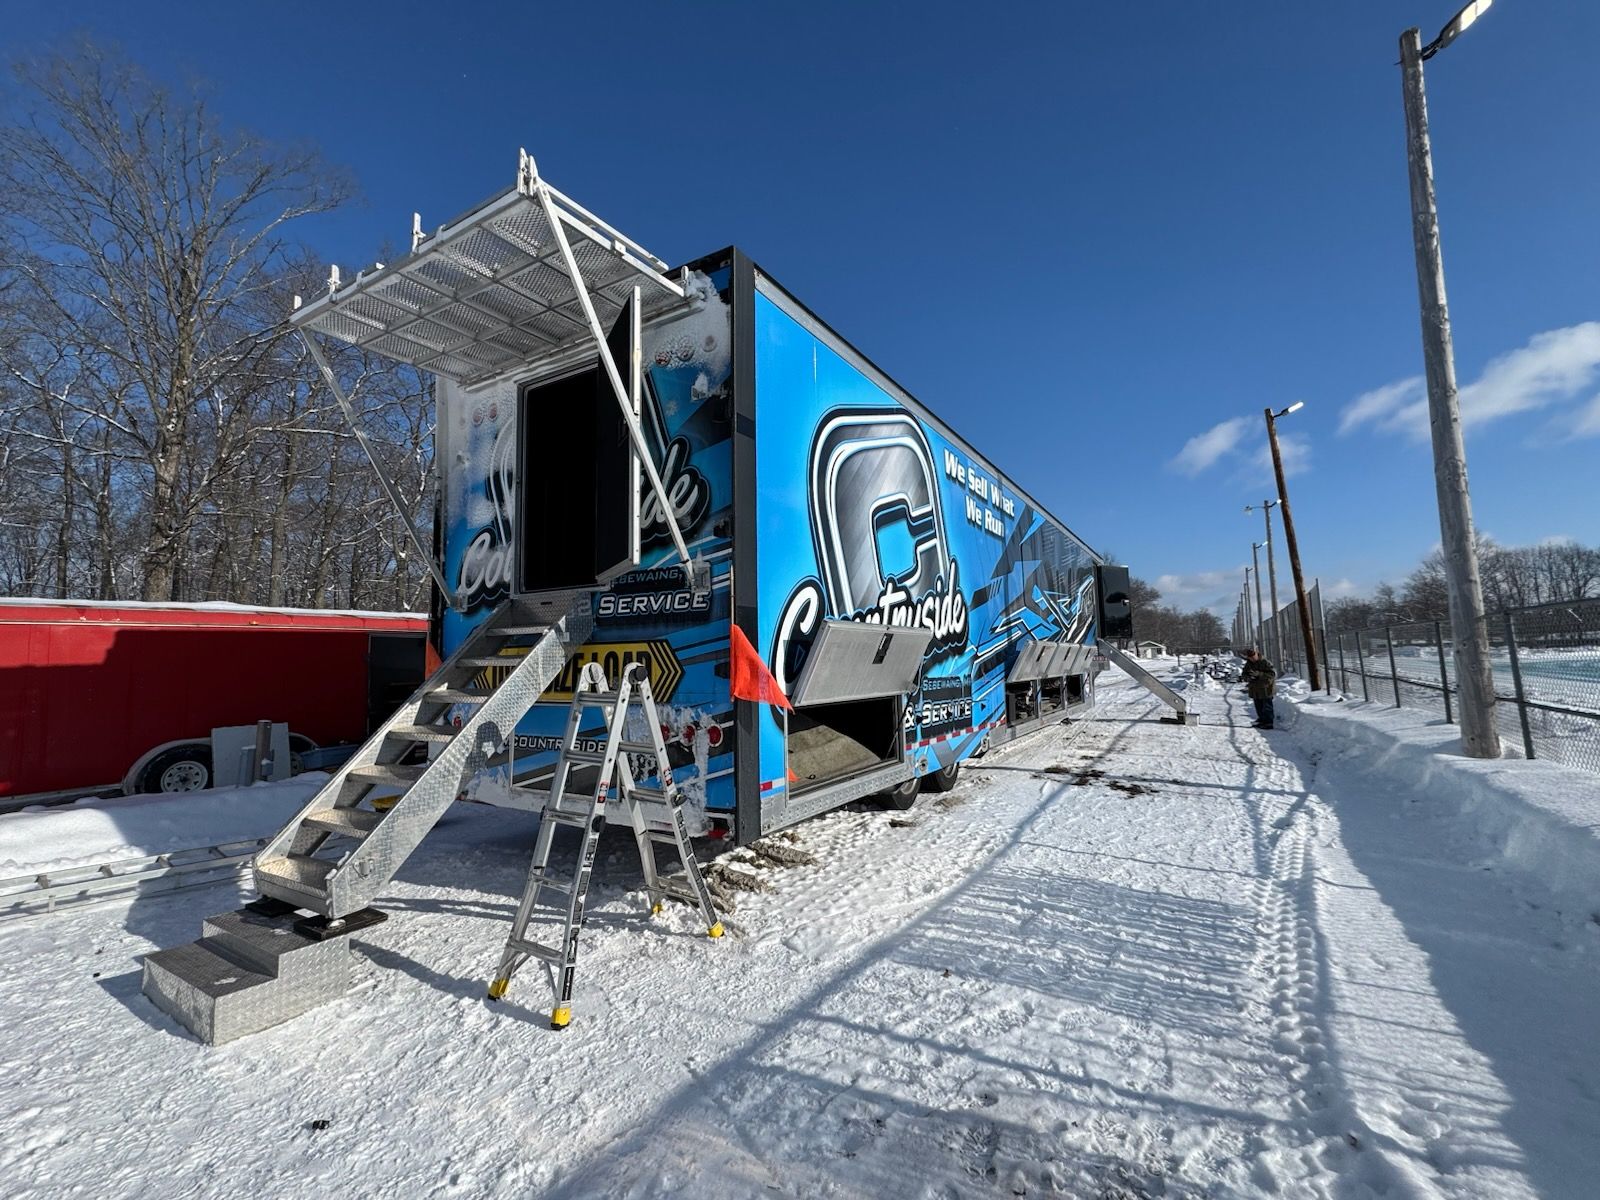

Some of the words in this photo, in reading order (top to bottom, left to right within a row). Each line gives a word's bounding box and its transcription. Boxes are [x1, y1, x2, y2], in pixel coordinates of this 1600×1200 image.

[944, 448, 966, 484] We
[967, 466, 989, 501] Sell
[990, 482, 1015, 517] What
[965, 494, 982, 526] We
[984, 508, 1005, 538] Run
[598, 590, 710, 615] SERVICE
[904, 706, 915, 728] &
[921, 698, 973, 725] SERVICE
